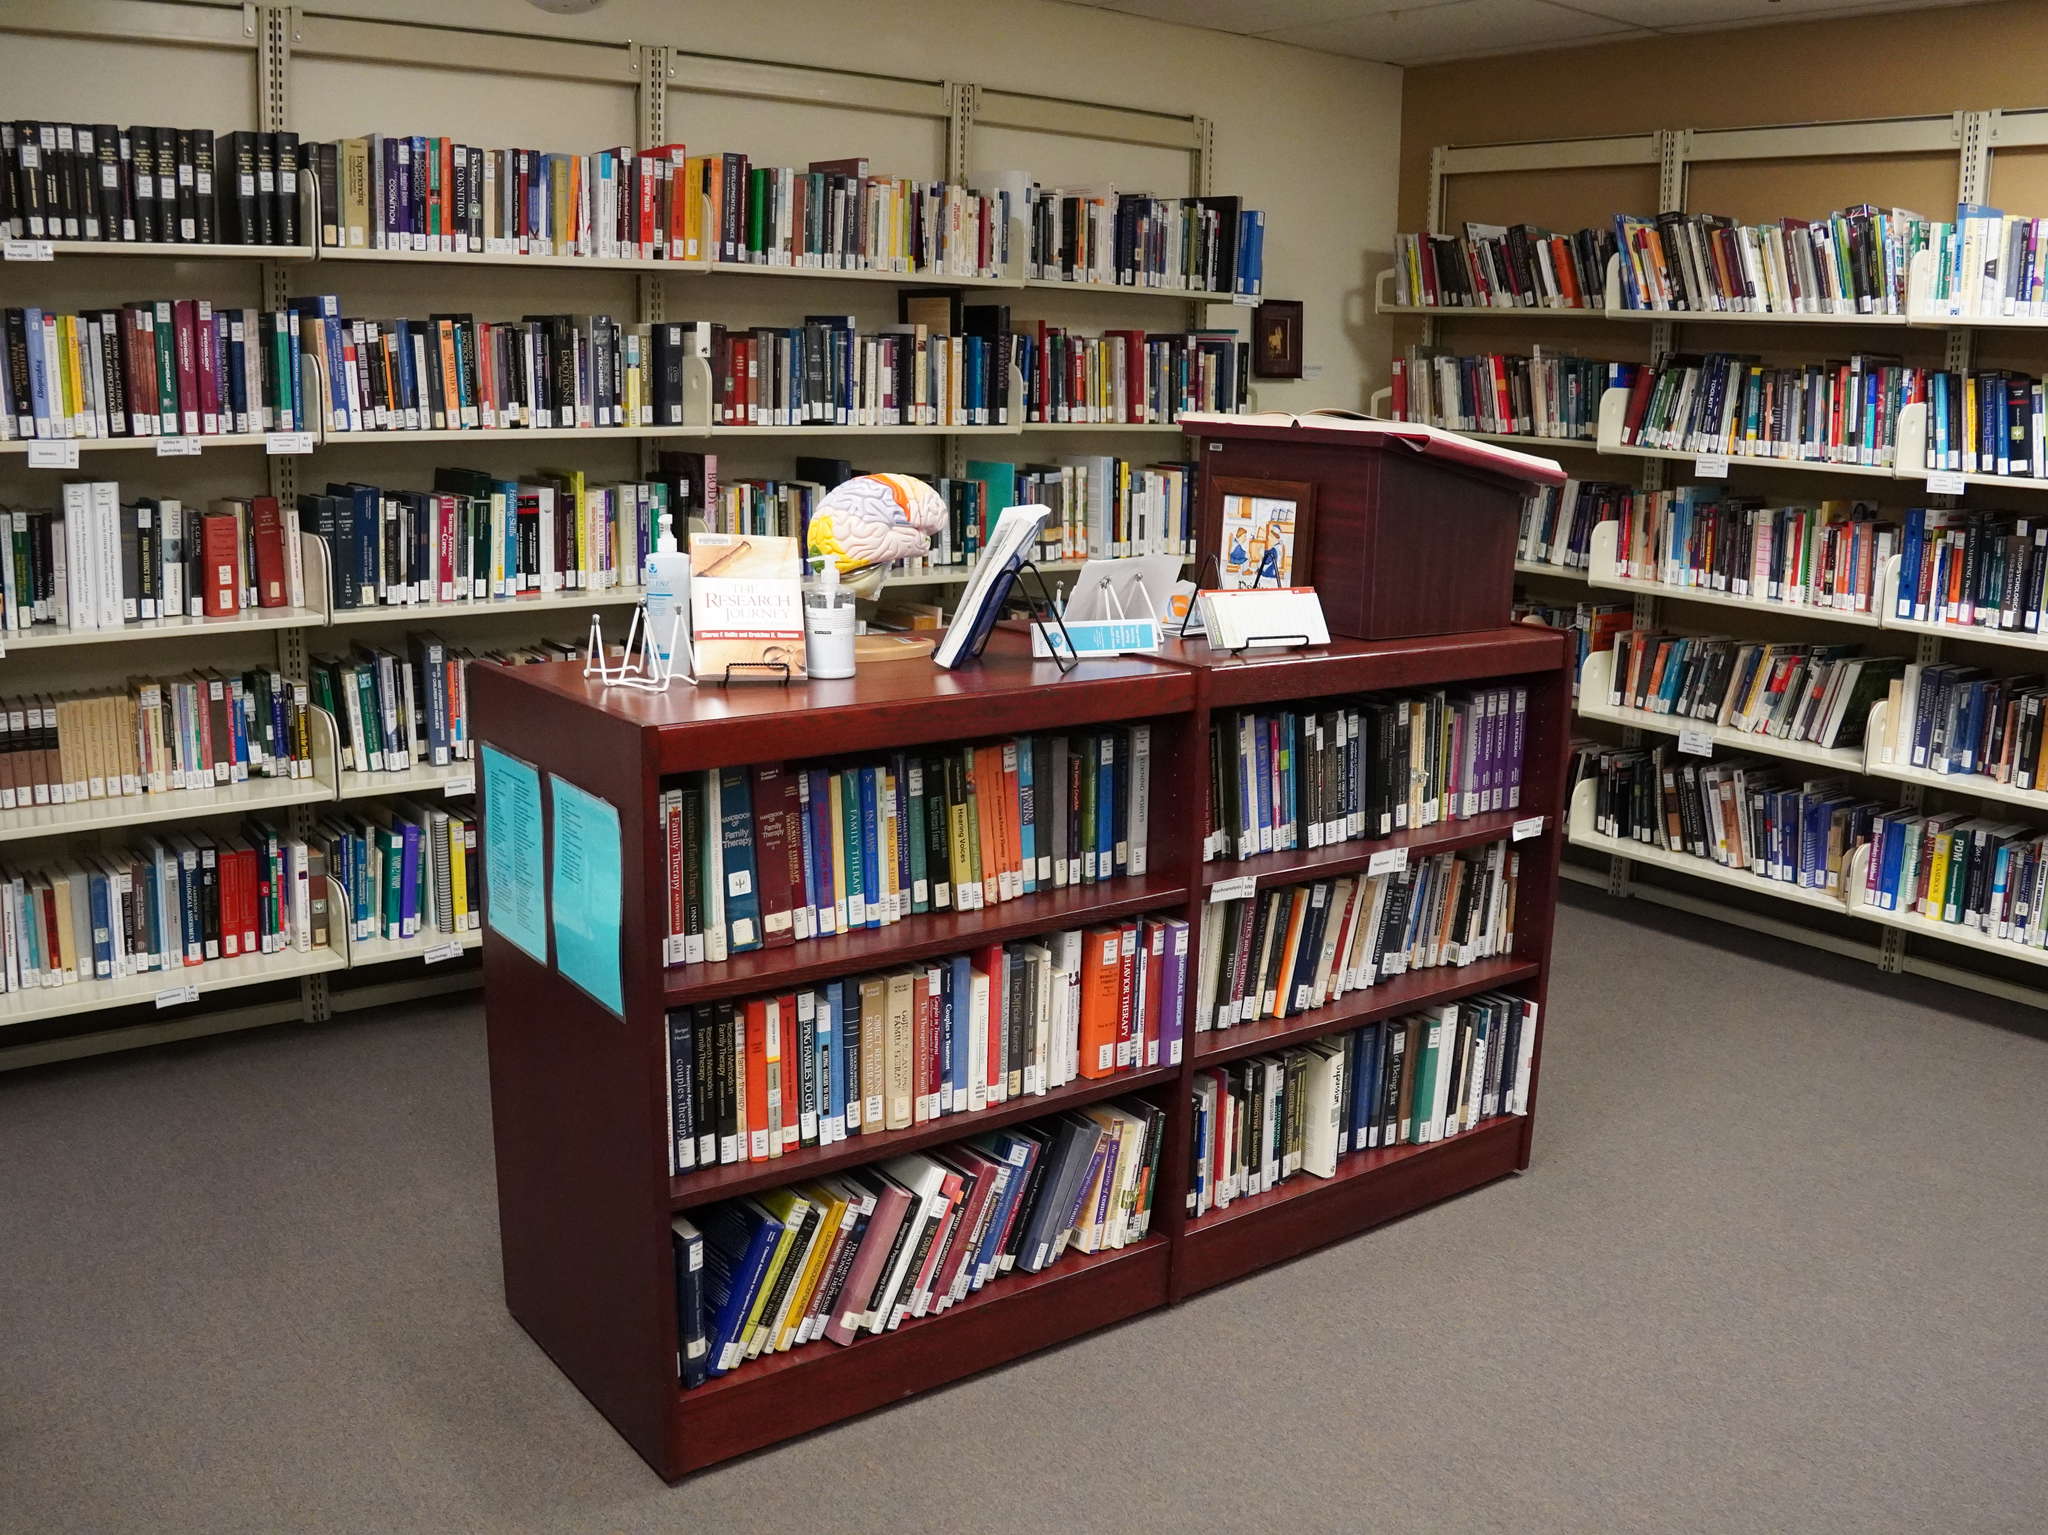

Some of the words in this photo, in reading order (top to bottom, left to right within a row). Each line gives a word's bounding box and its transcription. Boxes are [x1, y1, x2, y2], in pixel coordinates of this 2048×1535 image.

[670, 817, 682, 848] Family
[725, 829, 749, 840] Family
[850, 809, 859, 845] FAMILY
[956, 808, 966, 838] Hearing
[722, 838, 752, 848] Therapy
[959, 840, 968, 863] Voices
[1952, 839, 1965, 862] PDM
[670, 852, 682, 890] Therapy
[851, 851, 860, 894] THERAPY
[1245, 906, 1255, 938] TACTICS
[1122, 955, 1131, 996] EHAVIOR
[1226, 952, 1235, 978] FREUD
[1121, 997, 1130, 1036] THERAPY
[697, 1029, 706, 1052] Family
[717, 1024, 726, 1047] Family
[697, 1053, 706, 1081] Therapy
[717, 1048, 727, 1076] Therapy
[675, 1058, 686, 1099] couples
[737, 1082, 745, 1112] therapy
[677, 1103, 687, 1139] therapy
